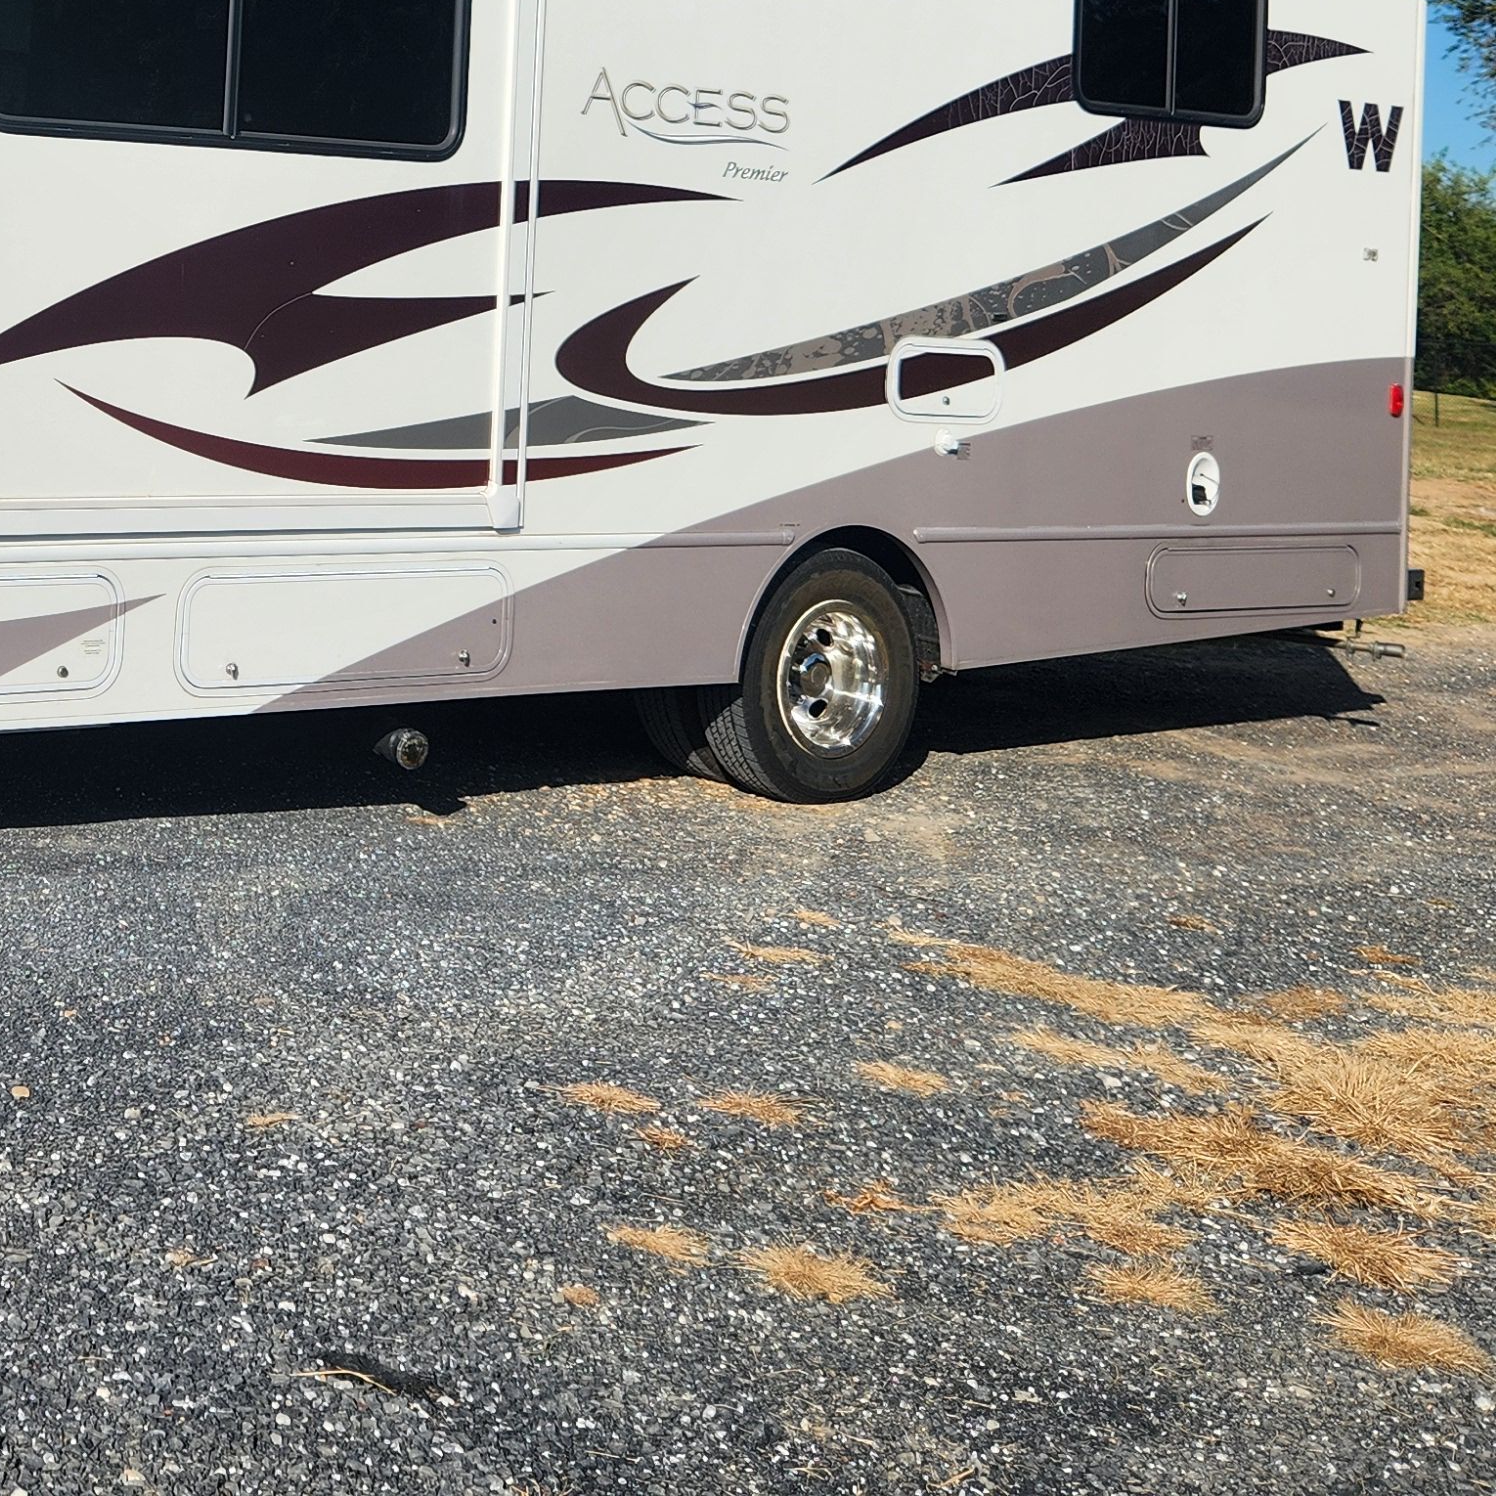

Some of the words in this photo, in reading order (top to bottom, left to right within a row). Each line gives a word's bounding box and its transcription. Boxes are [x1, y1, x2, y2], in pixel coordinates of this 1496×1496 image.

[580, 66, 791, 137] ACCESS
[1338, 99, 1404, 173] W
[721, 160, 789, 184] Premier
